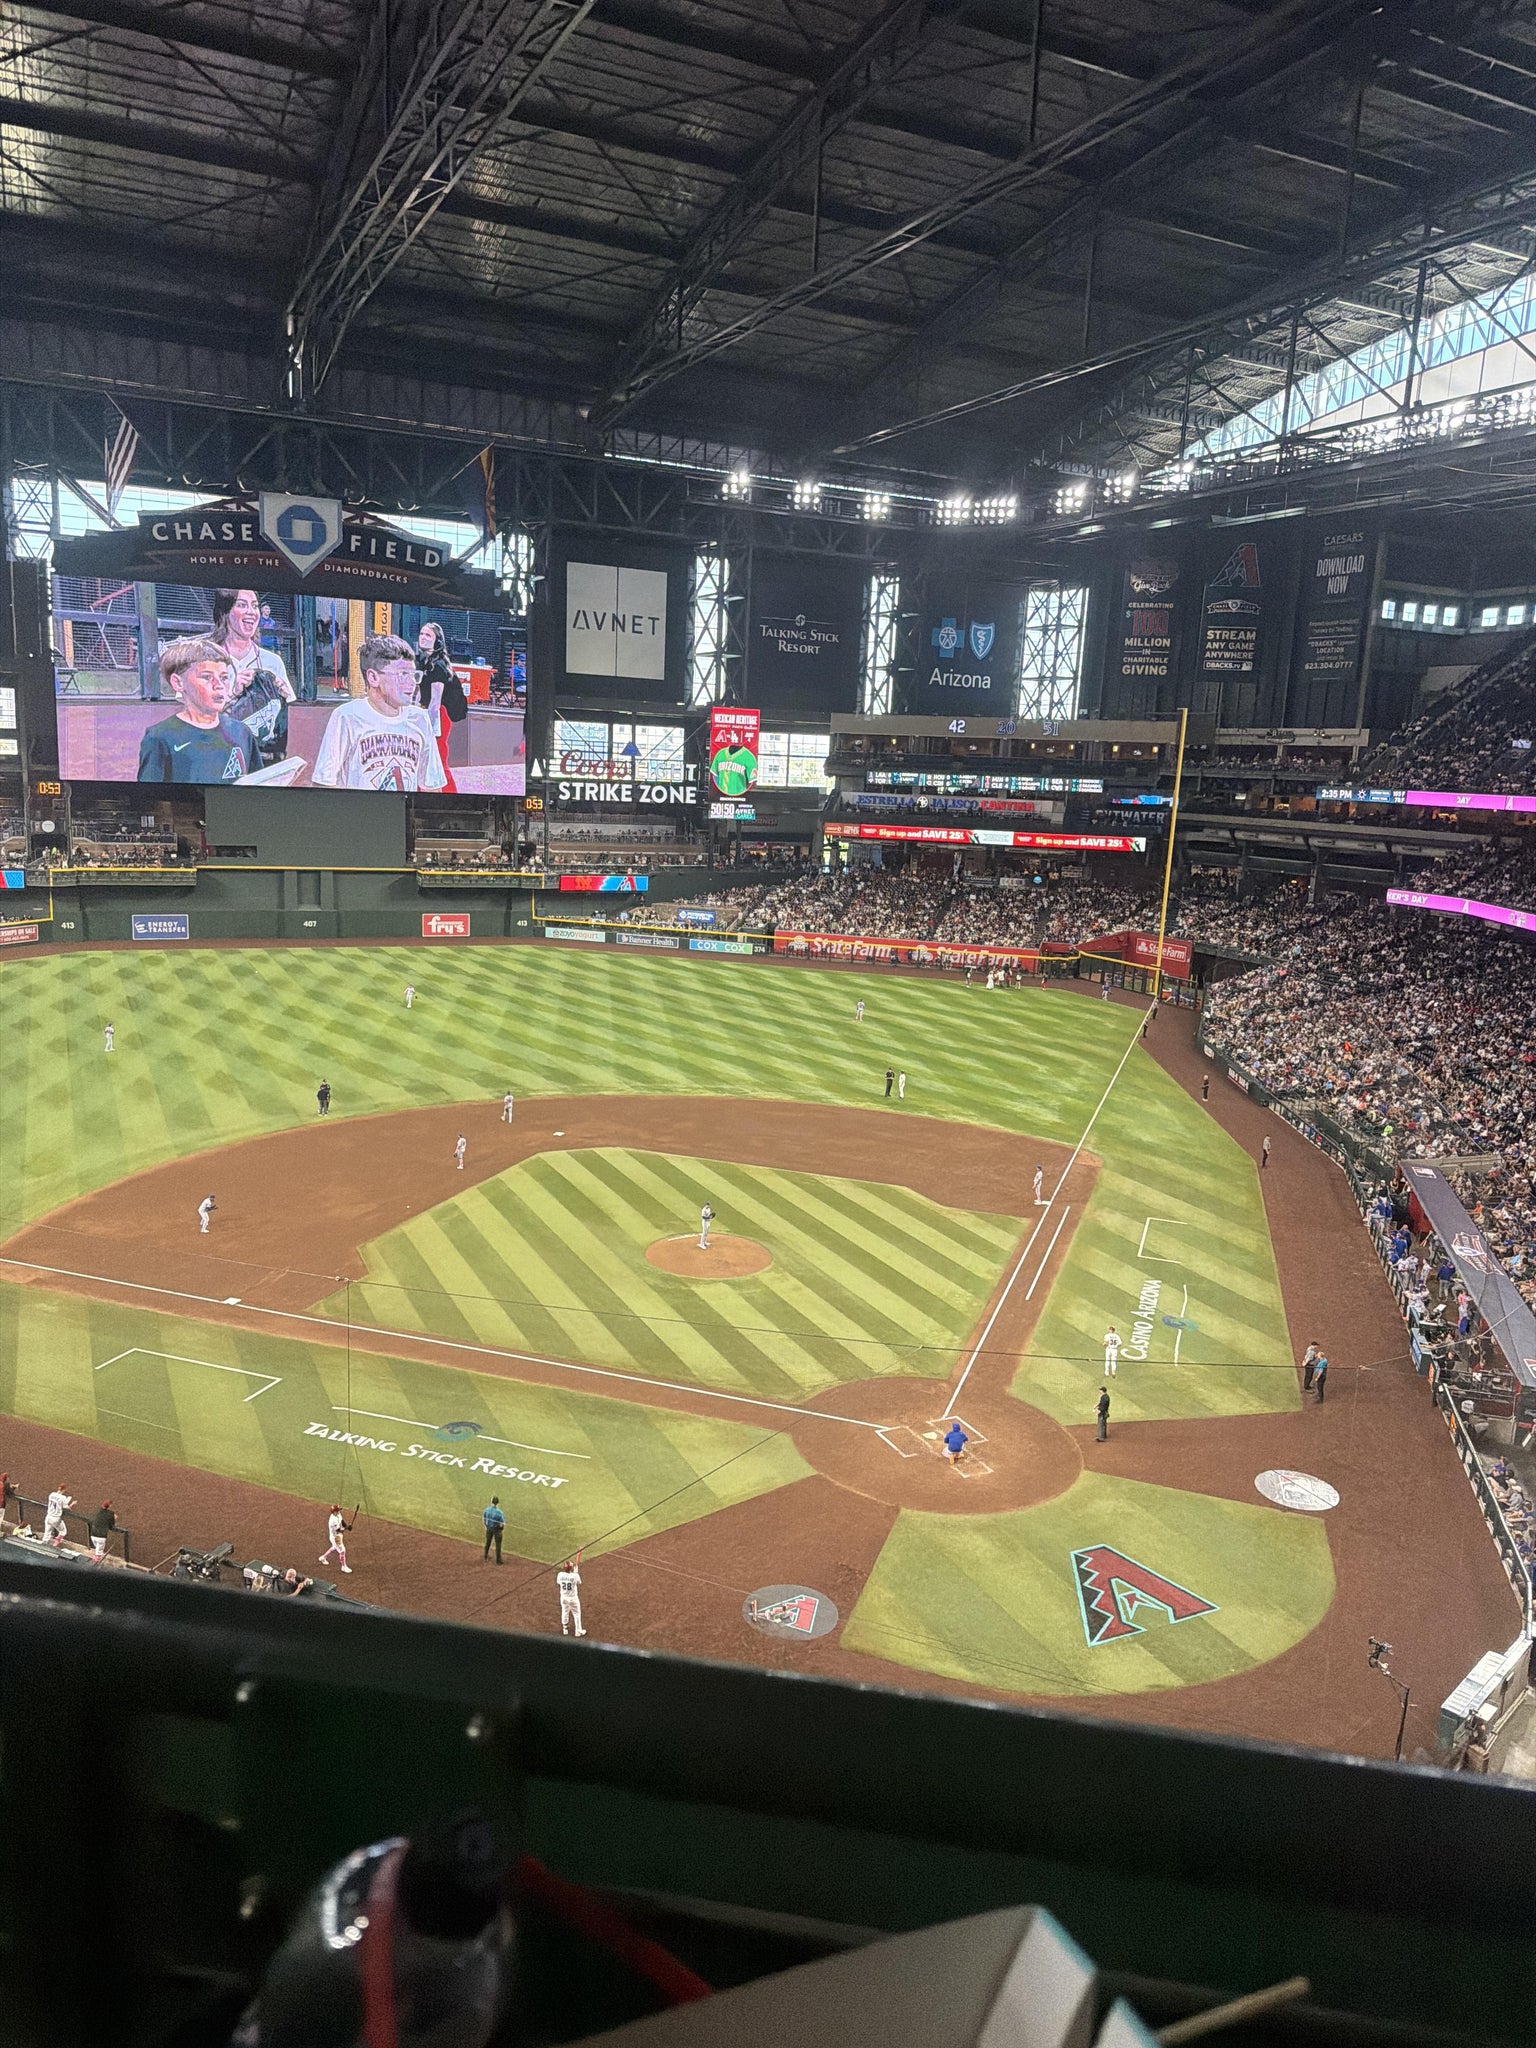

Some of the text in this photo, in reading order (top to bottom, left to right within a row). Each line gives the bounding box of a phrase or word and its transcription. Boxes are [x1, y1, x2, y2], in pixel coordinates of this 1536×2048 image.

[152, 522, 441, 567] CHASE FIELD
[1324, 532, 1364, 546] CAESARS
[190, 556, 280, 567] HOME OF THE
[1316, 554, 1365, 577] DOWNLOAD
[324, 563, 408, 584] DIAMONDBACKS
[1327, 575, 1349, 595] NOW
[572, 609, 660, 636] AVNET
[760, 624, 839, 643] TALKING STICK
[1206, 630, 1257, 641] STREAM
[778, 640, 821, 654] RESORT
[1124, 638, 1171, 648] MILLION
[1205, 641, 1255, 651] ANY GAME
[1142, 648, 1151, 656] IN
[1204, 651, 1254, 660] ANYWHERE
[1316, 646, 1345, 654] LOCATION
[1122, 656, 1169, 664] CHARITABLE
[1121, 664, 1168, 676] GIVING
[929, 668, 991, 689] Arizona
[948, 719, 1059, 737] 42 20 51
[559, 749, 629, 780] Coors
[38, 782, 61, 795] 0:53
[558, 781, 697, 805] STRIKE ZONE
[1321, 789, 1352, 799] 2:35 PM
[526, 798, 543, 810] 0:53
[856, 794, 915, 808] ESTRELLA
[930, 797, 979, 810] JALISCO
[879, 828, 896, 838] Sign
[896, 831, 906, 839] up
[907, 830, 922, 838] and
[922, 829, 948, 839] SAVE
[1035, 836, 1052, 846] Sign
[1064, 838, 1079, 846] and
[1080, 838, 1106, 847] SAVE
[1411, 895, 1429, 905] DAY
[60, 921, 75, 930] 413
[303, 919, 528, 929] 407 413
[427, 915, 465, 935] fry's
[629, 935, 674, 947] Banner Health
[697, 941, 745, 953] COX COX
[753, 946, 765, 954] 374
[1130, 1279, 1163, 1321] ARIZONA
[1120, 1321, 1154, 1360] CASINO
[303, 1421, 569, 1489] TALKING STICK RESORT
[561, 1582, 572, 1591] 28
